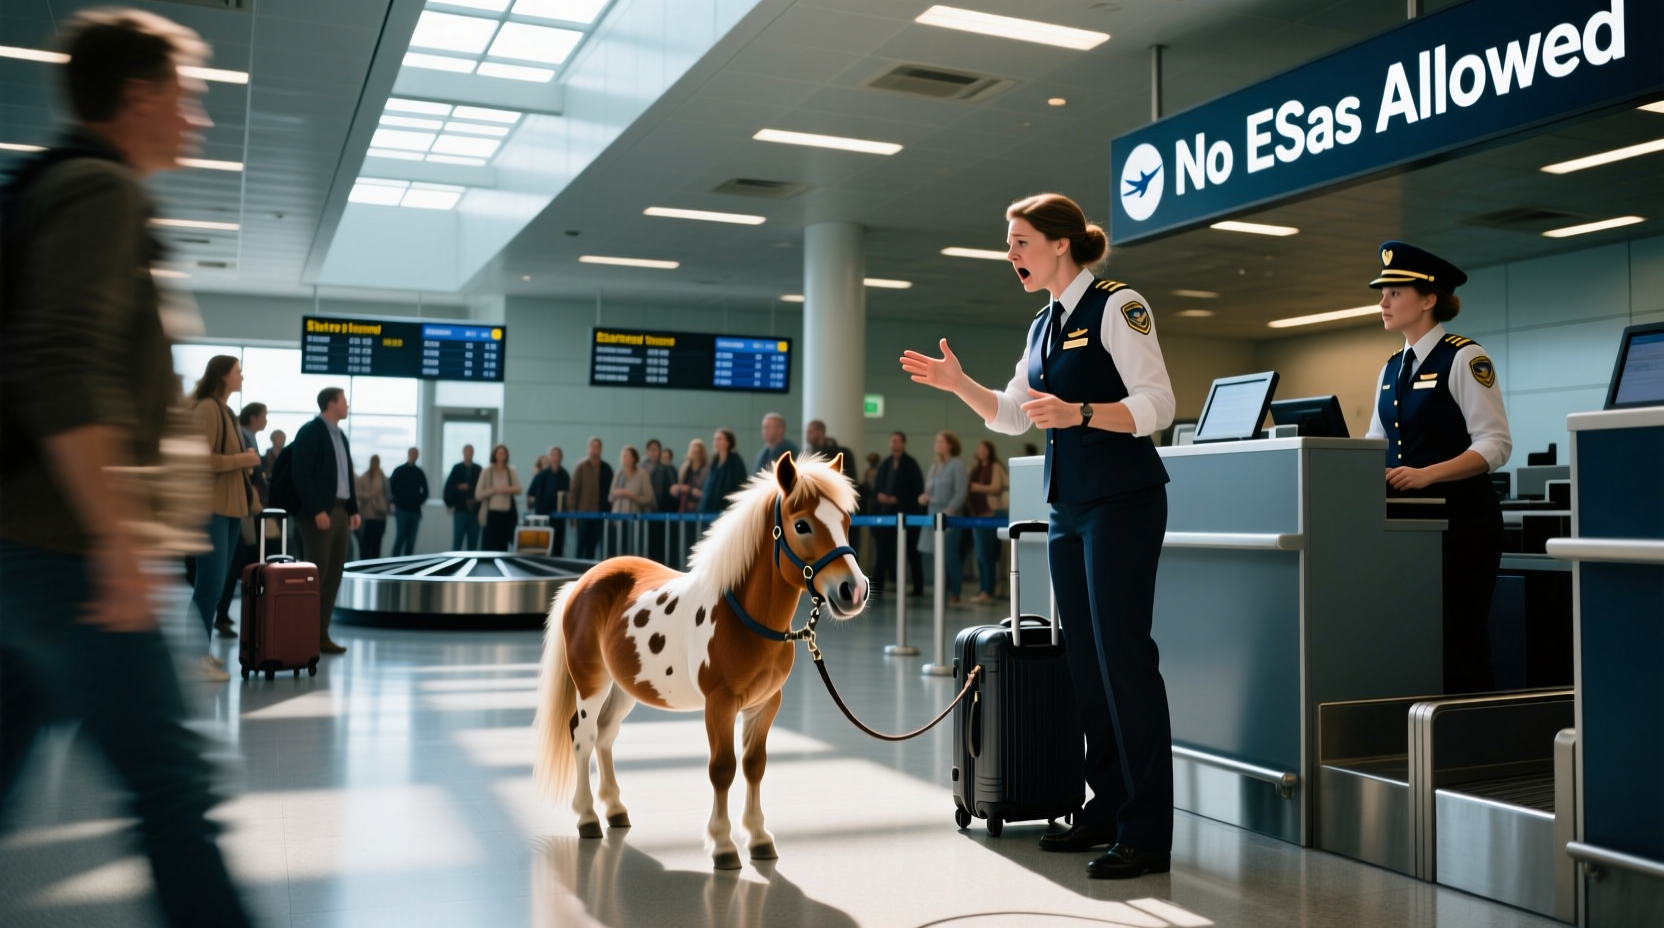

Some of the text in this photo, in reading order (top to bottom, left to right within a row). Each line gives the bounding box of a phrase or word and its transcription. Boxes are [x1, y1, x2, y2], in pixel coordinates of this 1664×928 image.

[1176, 0, 1625, 195] No ESas Allowed
